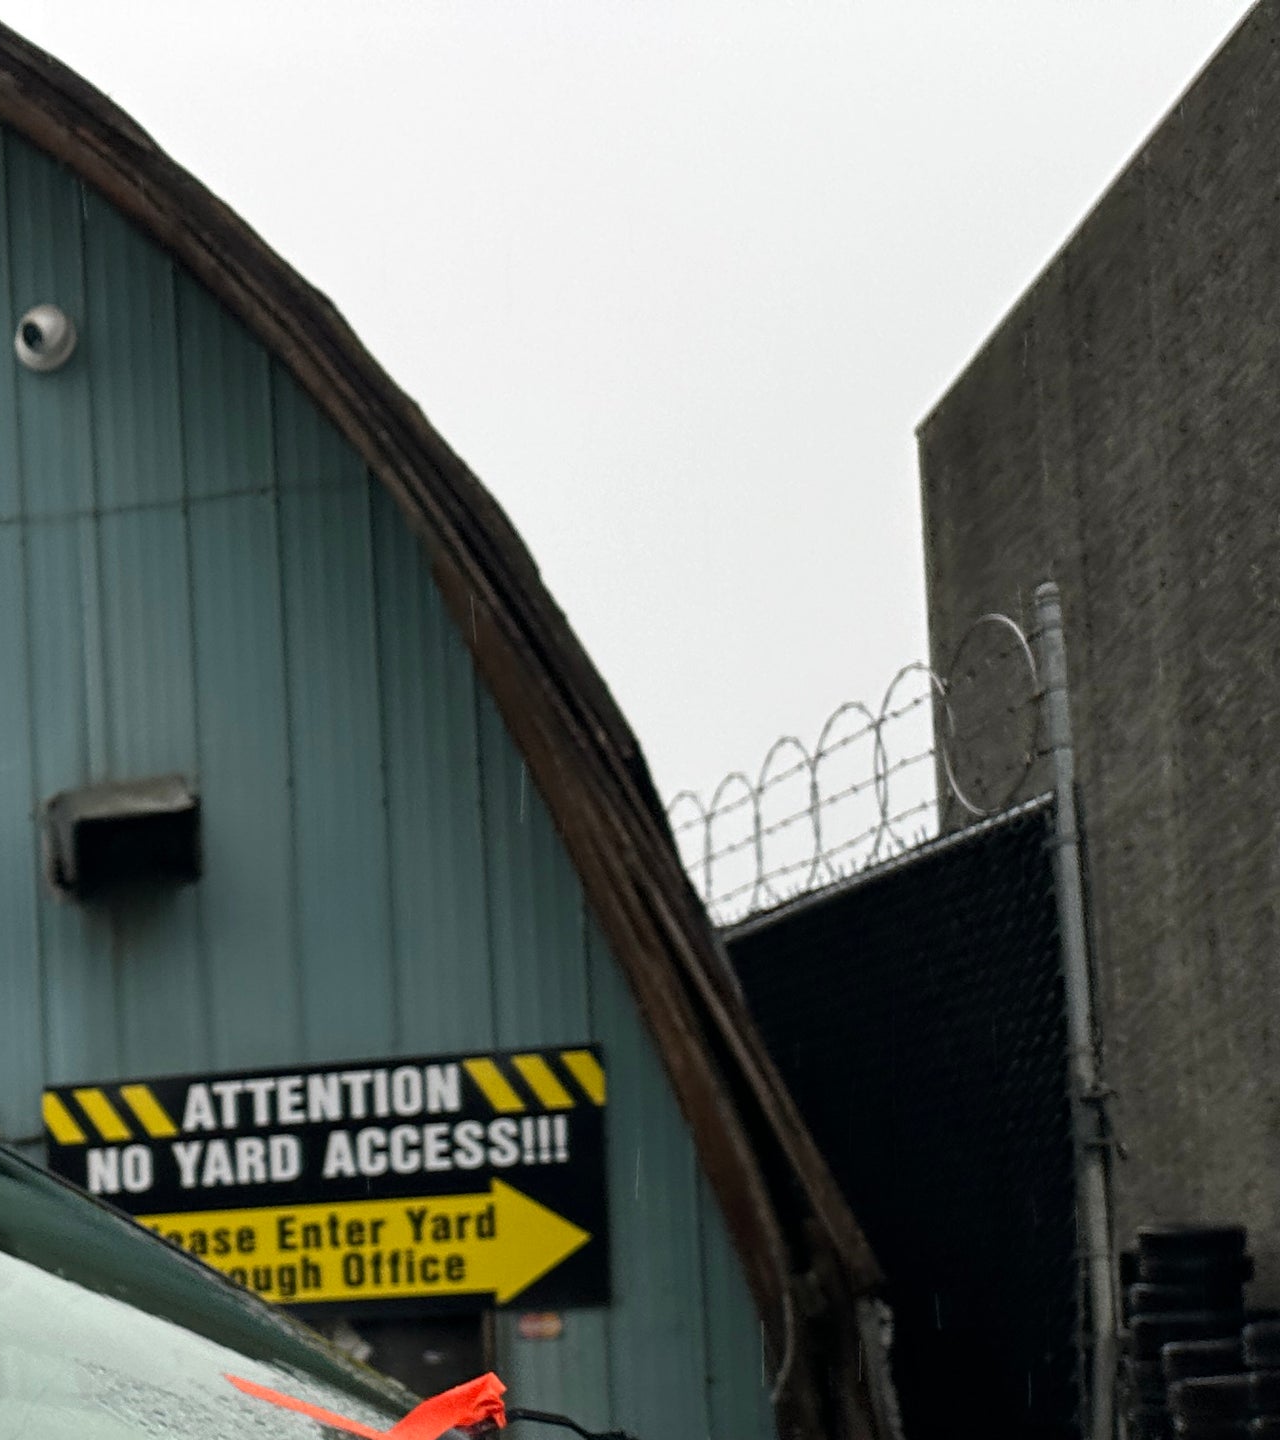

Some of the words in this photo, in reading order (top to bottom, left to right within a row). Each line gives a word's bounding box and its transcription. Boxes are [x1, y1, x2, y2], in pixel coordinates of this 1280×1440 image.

[181, 1063, 462, 1133] ATTENTION
[86, 1144, 153, 1195] NO
[172, 1133, 302, 1189] YARD
[323, 1115, 569, 1179] ACCESS!!!
[151, 1222, 257, 1255] ease
[276, 1212, 385, 1251] Enter
[405, 1202, 496, 1244] Yard
[222, 1256, 322, 1296] ough
[342, 1248, 467, 1287] Office
